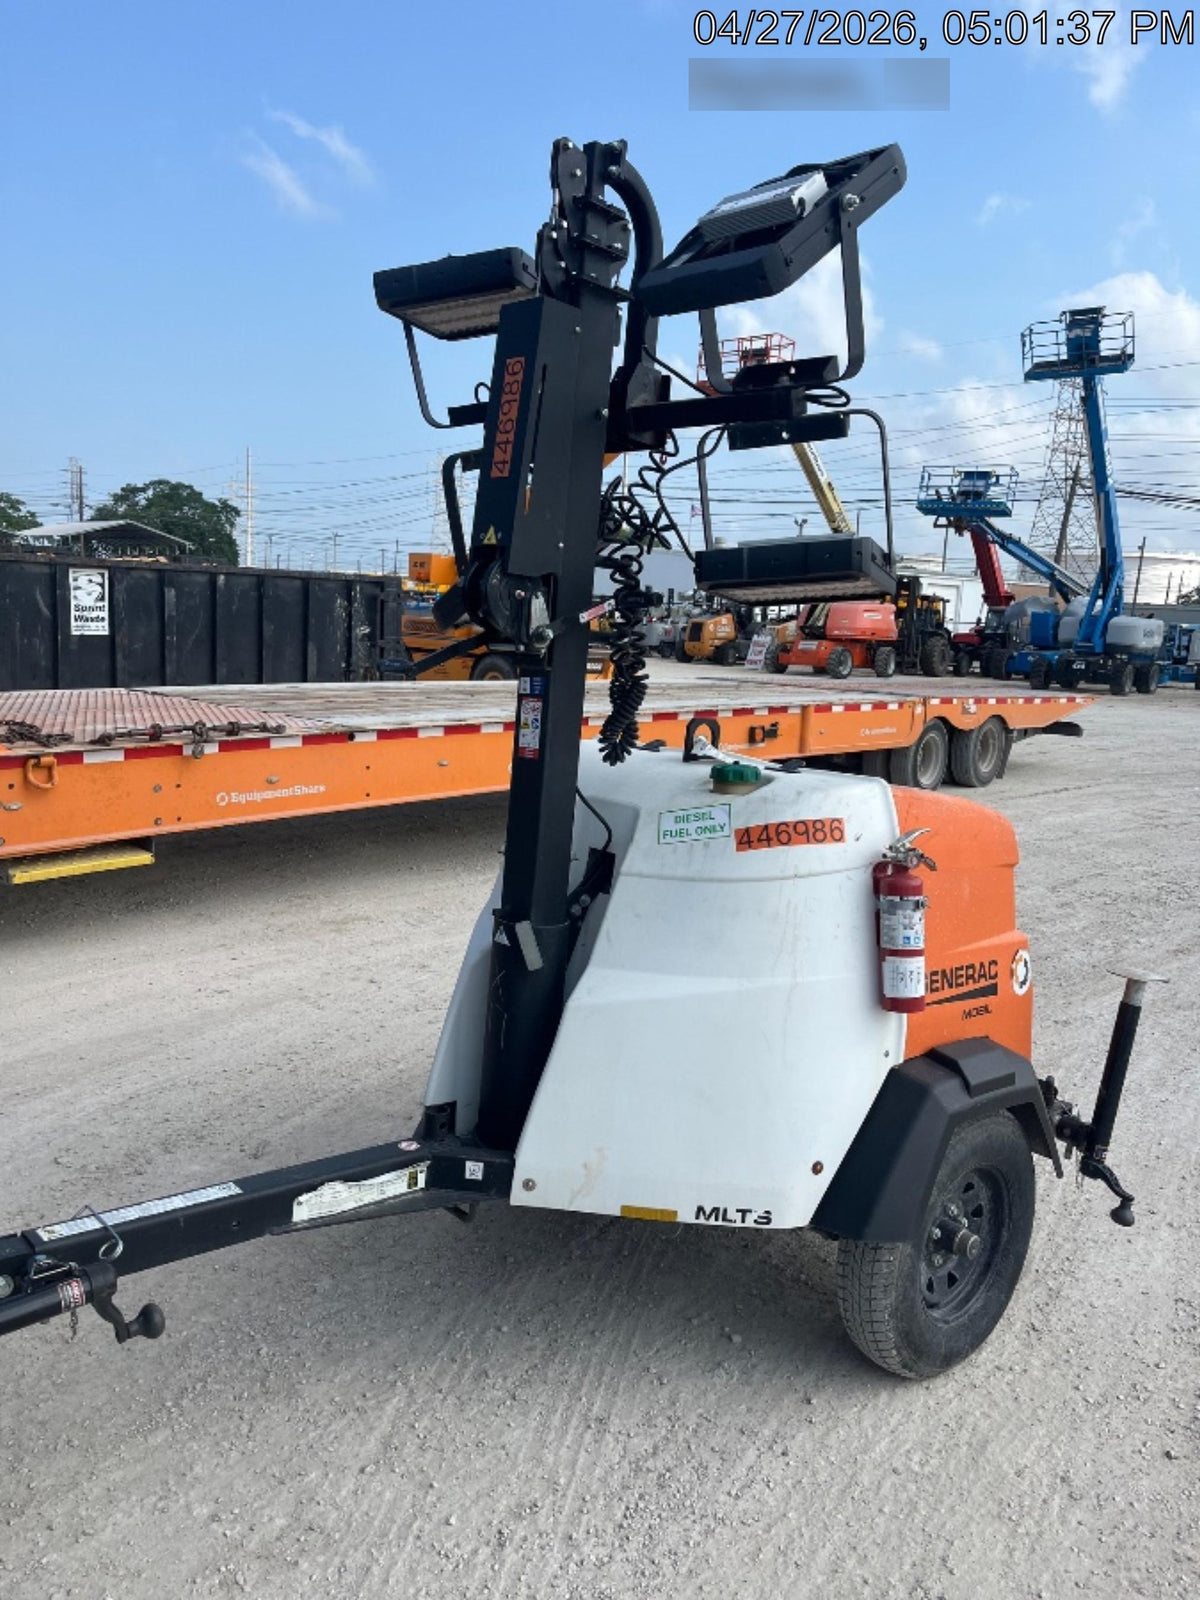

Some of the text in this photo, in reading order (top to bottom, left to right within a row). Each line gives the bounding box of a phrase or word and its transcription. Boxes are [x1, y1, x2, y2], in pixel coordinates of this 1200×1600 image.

[493, 358, 524, 476] 446986
[74, 614, 106, 623] Waste
[230, 784, 326, 804] EquipmentShare
[674, 810, 716, 824] DIESEL
[662, 822, 727, 840] FUEL ONLY
[738, 819, 845, 848] 446986
